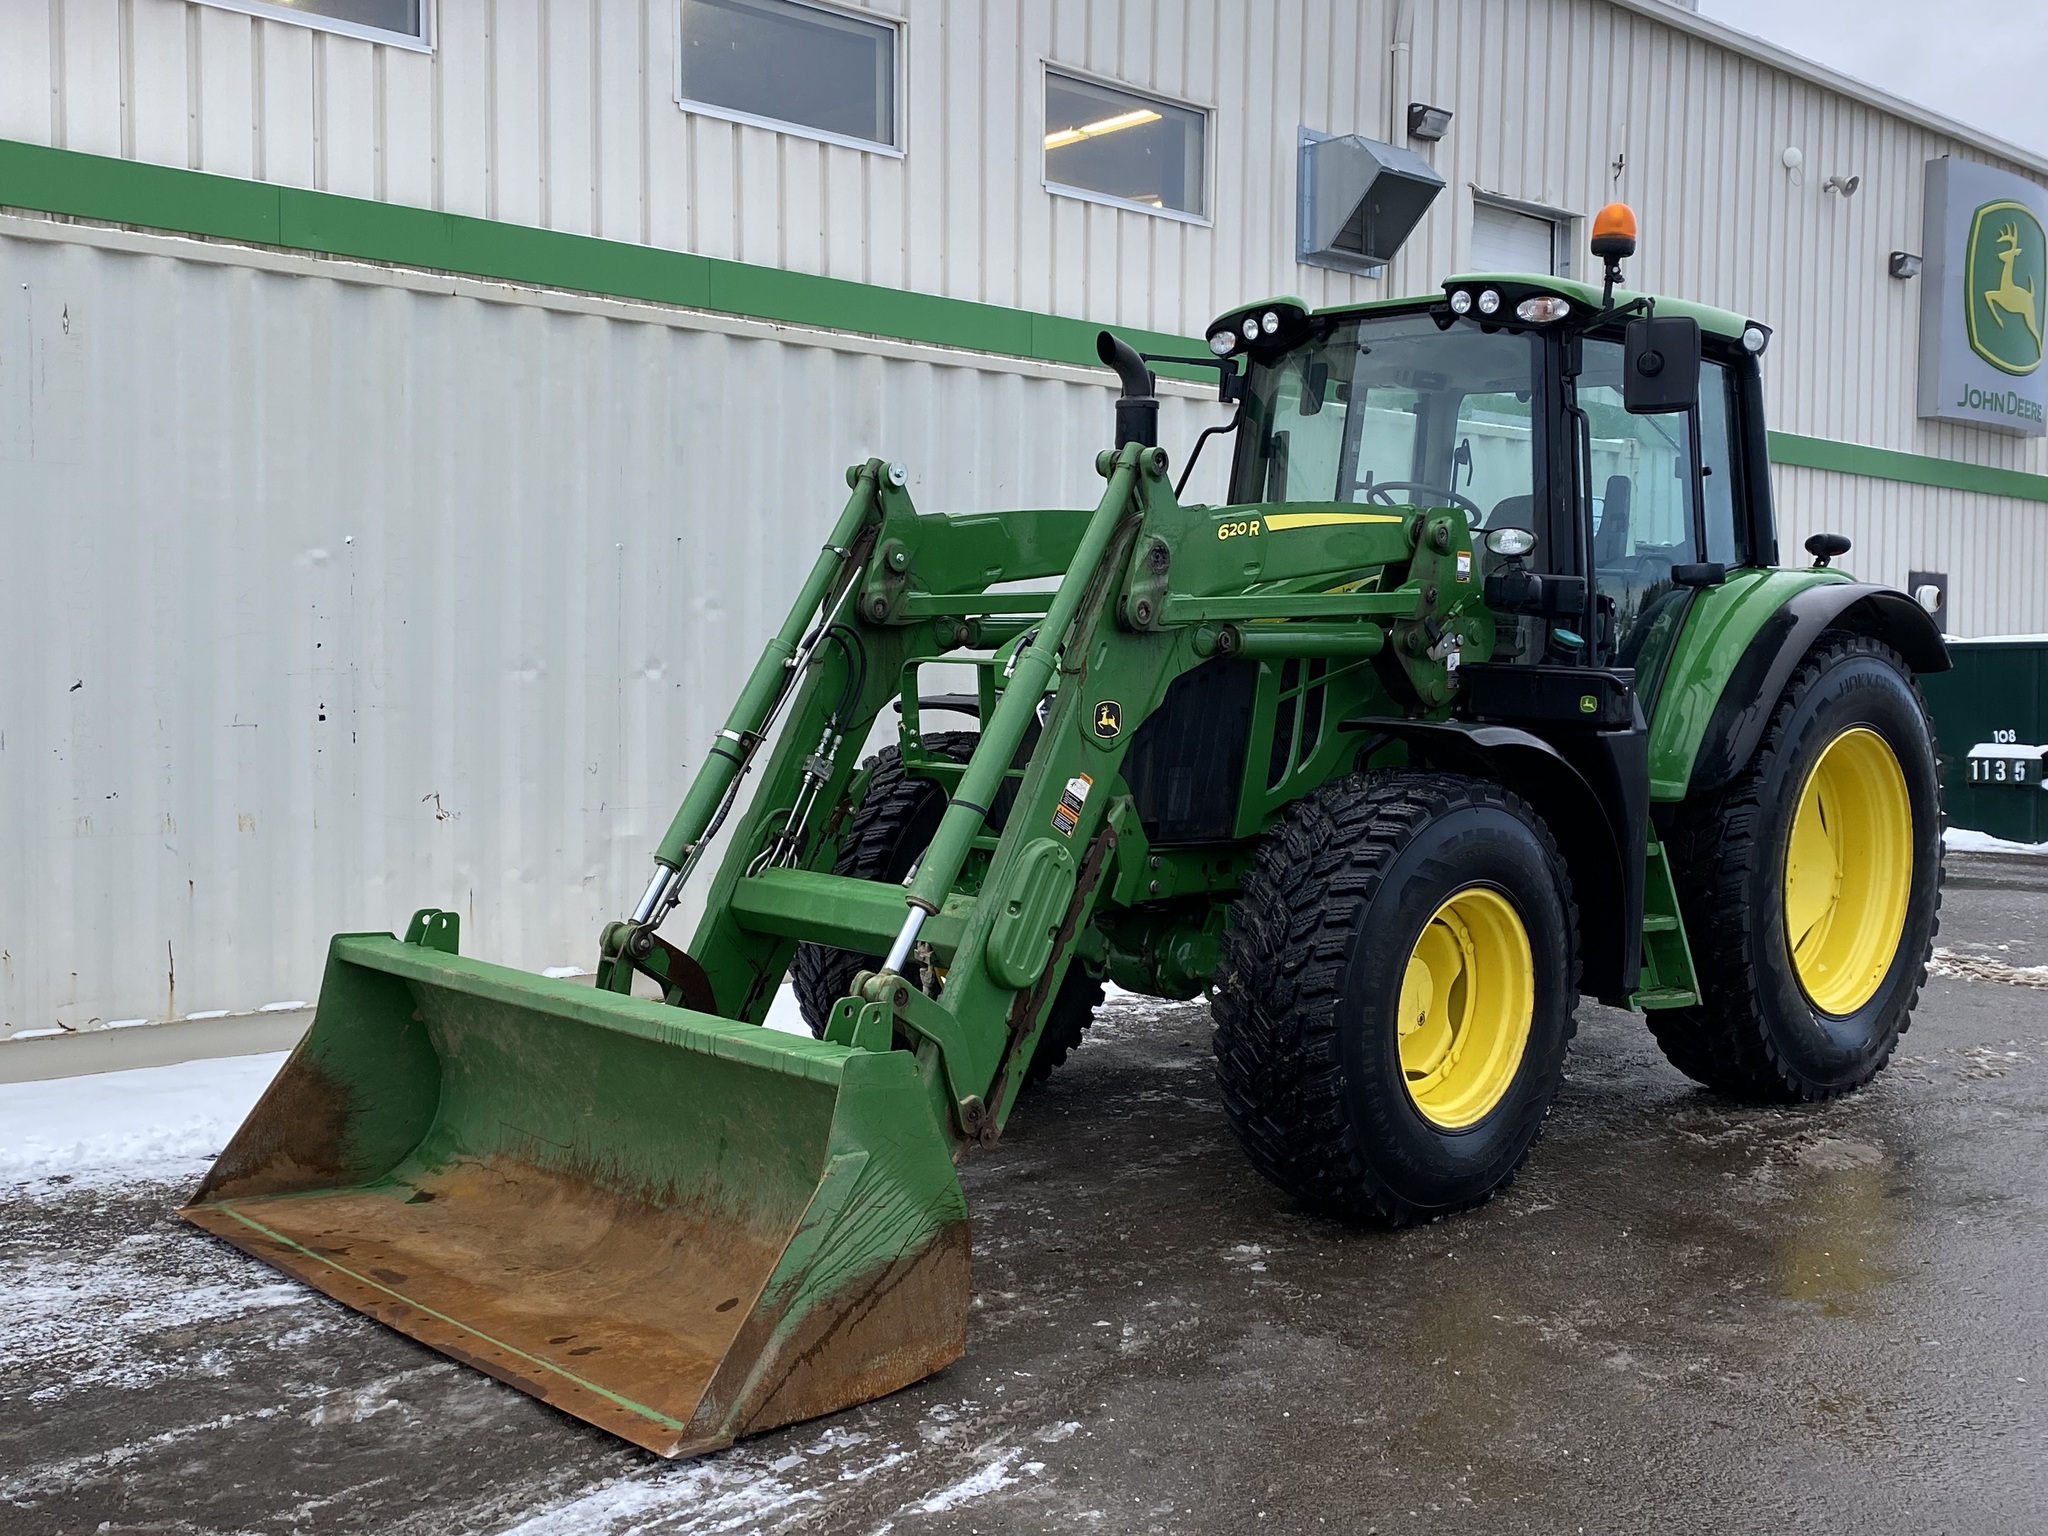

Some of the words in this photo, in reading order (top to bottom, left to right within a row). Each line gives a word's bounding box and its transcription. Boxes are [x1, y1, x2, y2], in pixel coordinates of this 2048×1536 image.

[1957, 383, 2005, 413] JOHN
[2006, 391, 2042, 424] DEERE
[1993, 729, 2016, 743] 108
